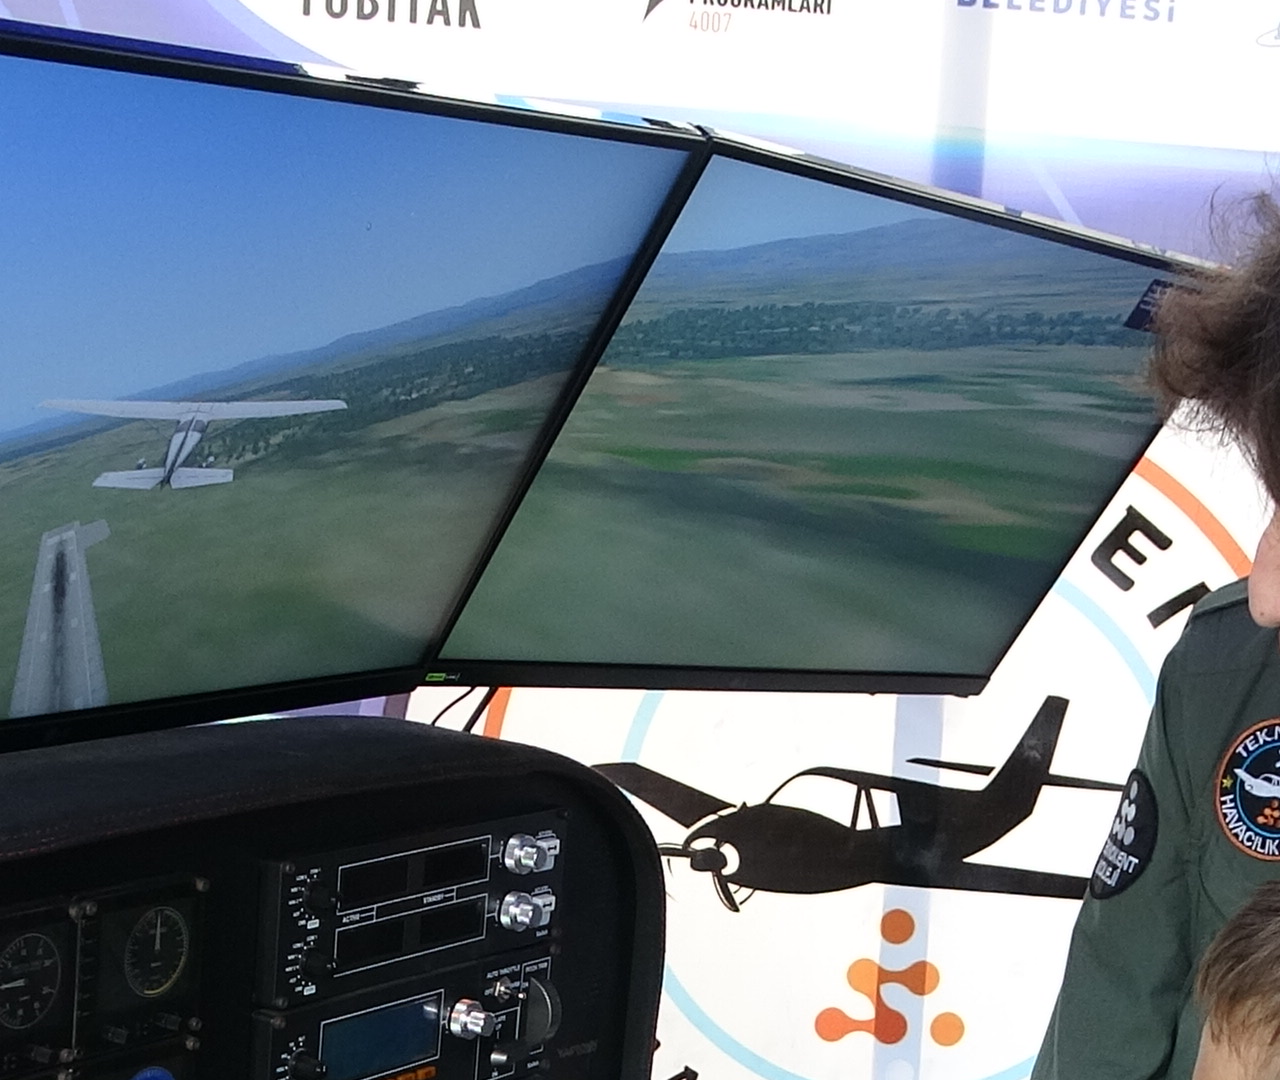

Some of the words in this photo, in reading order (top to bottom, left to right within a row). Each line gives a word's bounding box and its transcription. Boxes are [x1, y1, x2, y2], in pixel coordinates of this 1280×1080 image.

[689, 0, 833, 15] AMLARI
[688, 10, 732, 33] 4007
[1220, 794, 1280, 855] HAVACILIK
